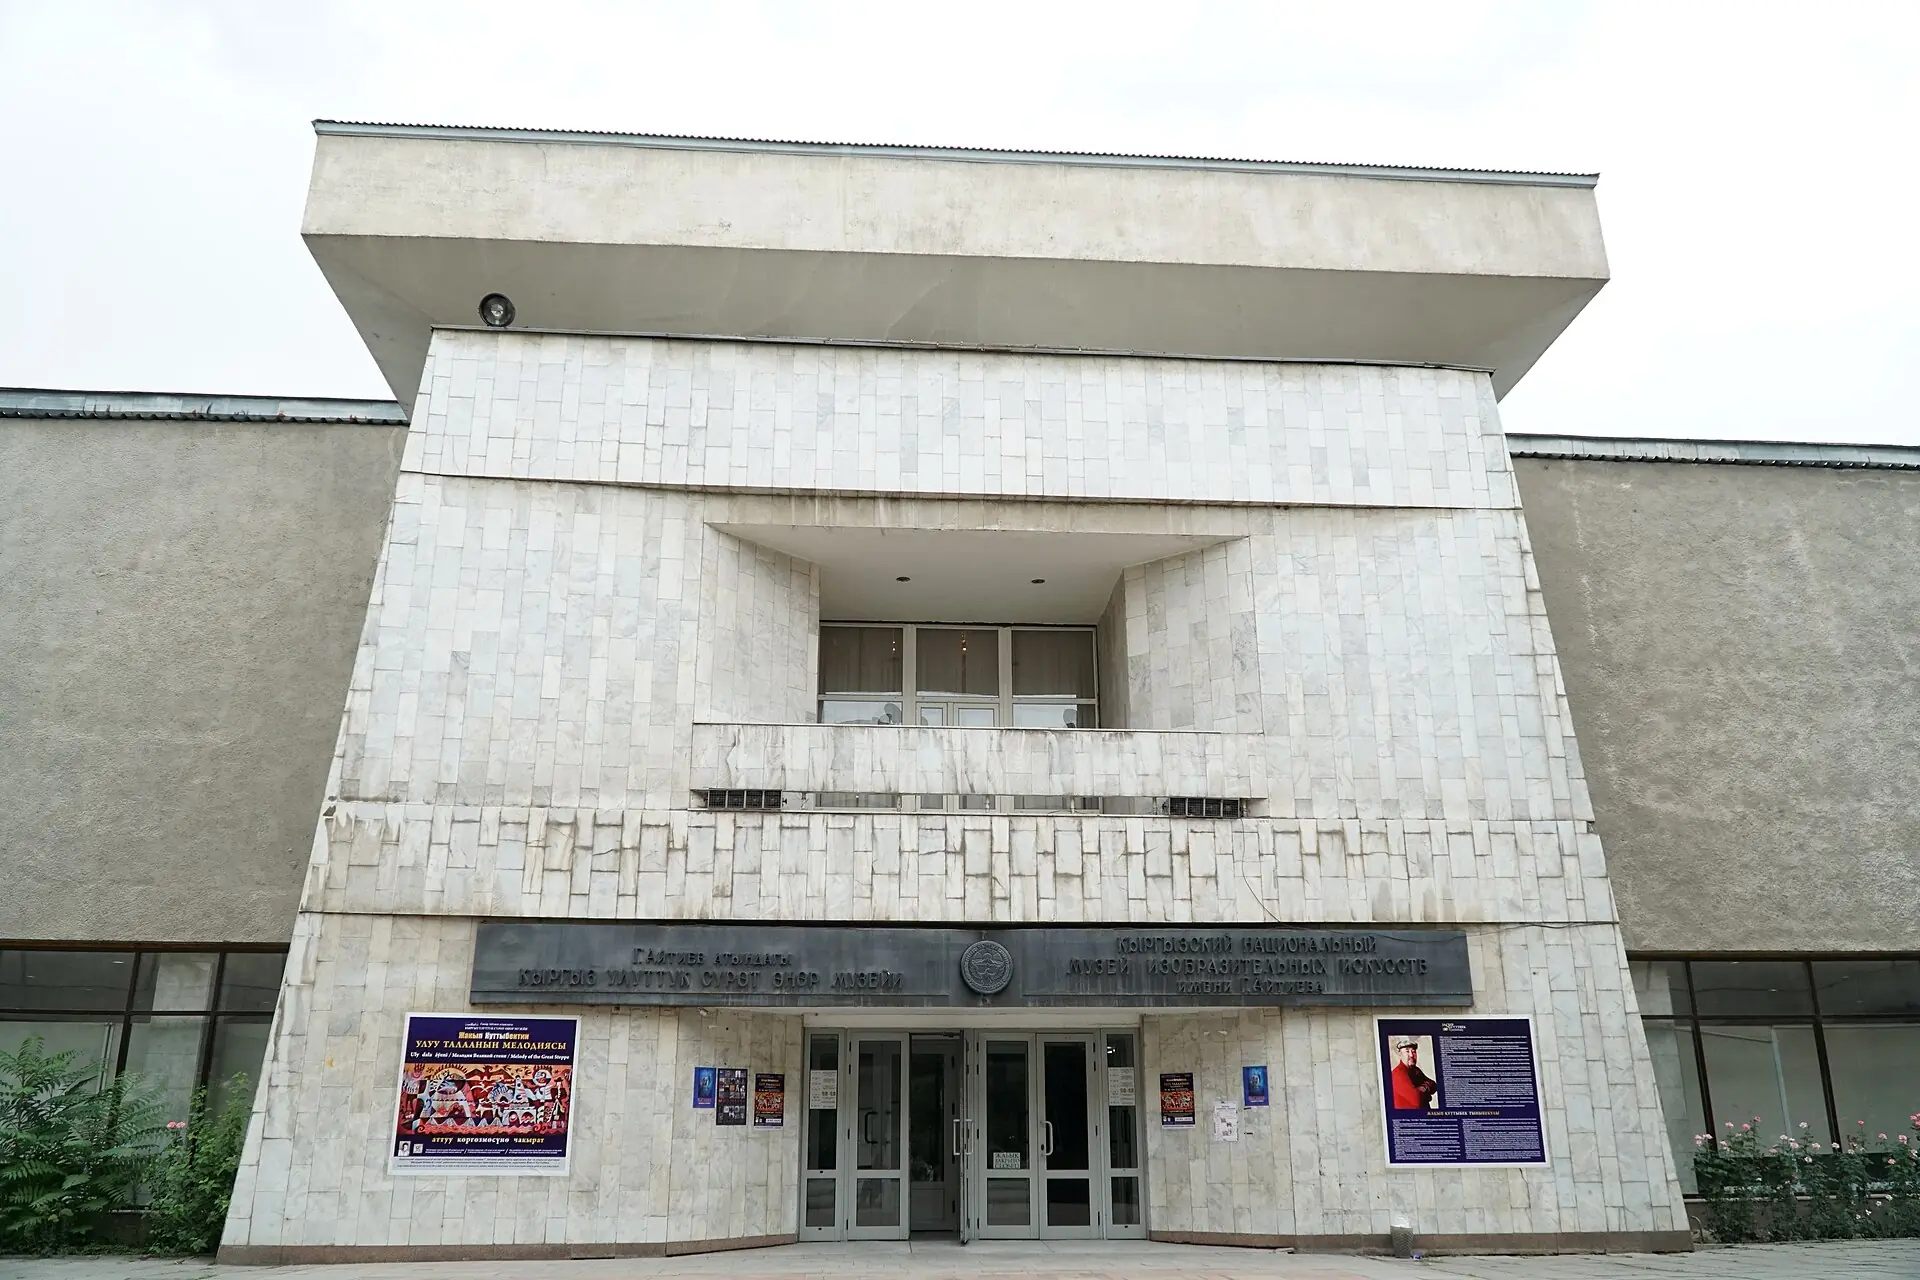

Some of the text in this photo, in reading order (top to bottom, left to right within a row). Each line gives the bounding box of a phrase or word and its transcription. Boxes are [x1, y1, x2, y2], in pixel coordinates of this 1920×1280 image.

[1117, 934, 1377, 955] КЫРГЫЗСКИЙ НАЦИОНАЛЬНЫЙ
[714, 952, 793, 967] АТЫНДАГЫ
[1066, 955, 1428, 976] МУЗЕЙ ИЗОБРАЗИТЕЛЬНЫХ ИСКУССТВ
[518, 968, 597, 986] КЫРГЫЗ
[607, 969, 692, 988] УЛУТТУК
[831, 968, 905, 990] МУЗЕЙИ
[1177, 980, 1233, 994] ИМЕНИ
[415, 1040, 567, 1051] УЛУУ ТАЛААНЫН МЕЛОДИЯСЫ
[513, 1137, 545, 1146] чакырат
